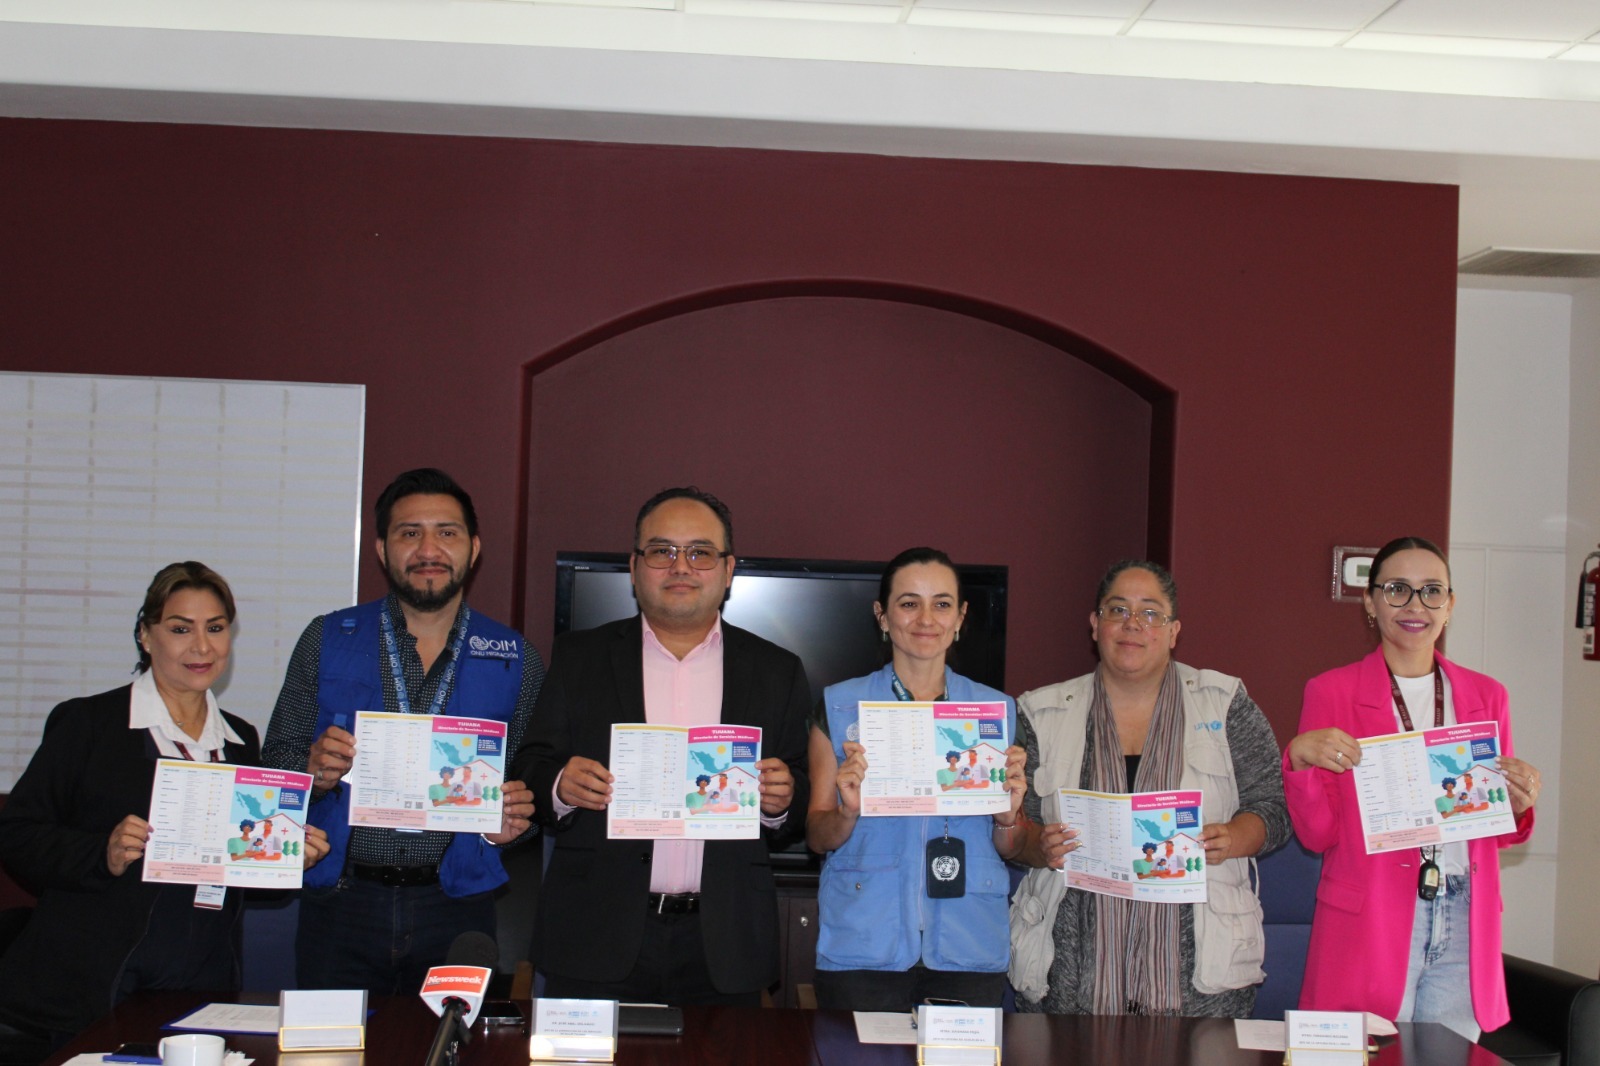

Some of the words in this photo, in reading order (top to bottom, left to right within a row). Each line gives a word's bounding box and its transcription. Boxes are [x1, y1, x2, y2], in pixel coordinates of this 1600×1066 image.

[384, 632, 393, 645] OIM
[490, 640, 517, 651] OIM
[389, 654, 398, 668] OIM
[445, 668, 454, 682] OIM
[394, 677, 403, 691] OIM
[436, 690, 446, 704] OIM
[427, 976, 482, 985] Newsweek
